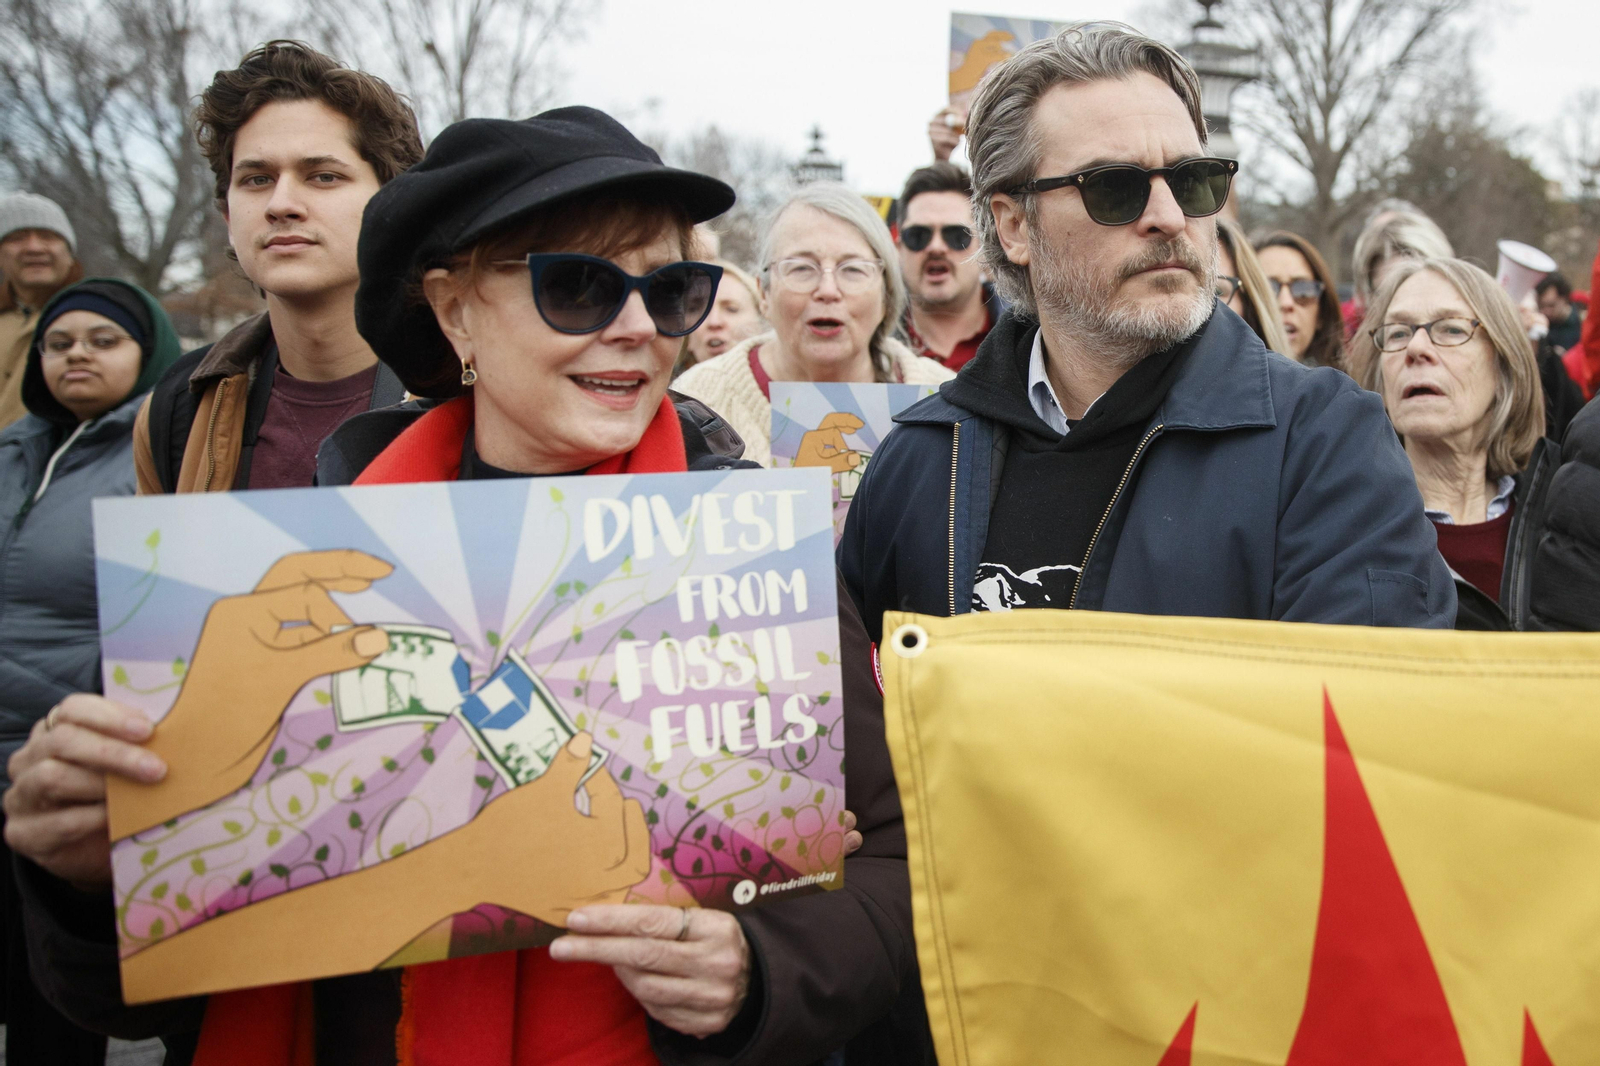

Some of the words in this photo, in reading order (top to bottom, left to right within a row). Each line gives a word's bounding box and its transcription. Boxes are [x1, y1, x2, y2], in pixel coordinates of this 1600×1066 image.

[584, 490, 808, 563] DIVEST
[677, 569, 808, 623] FROM
[615, 626, 812, 703] FOSSIL
[650, 693, 818, 763] FUELS
[760, 871, 837, 895] @firedrillfriday
